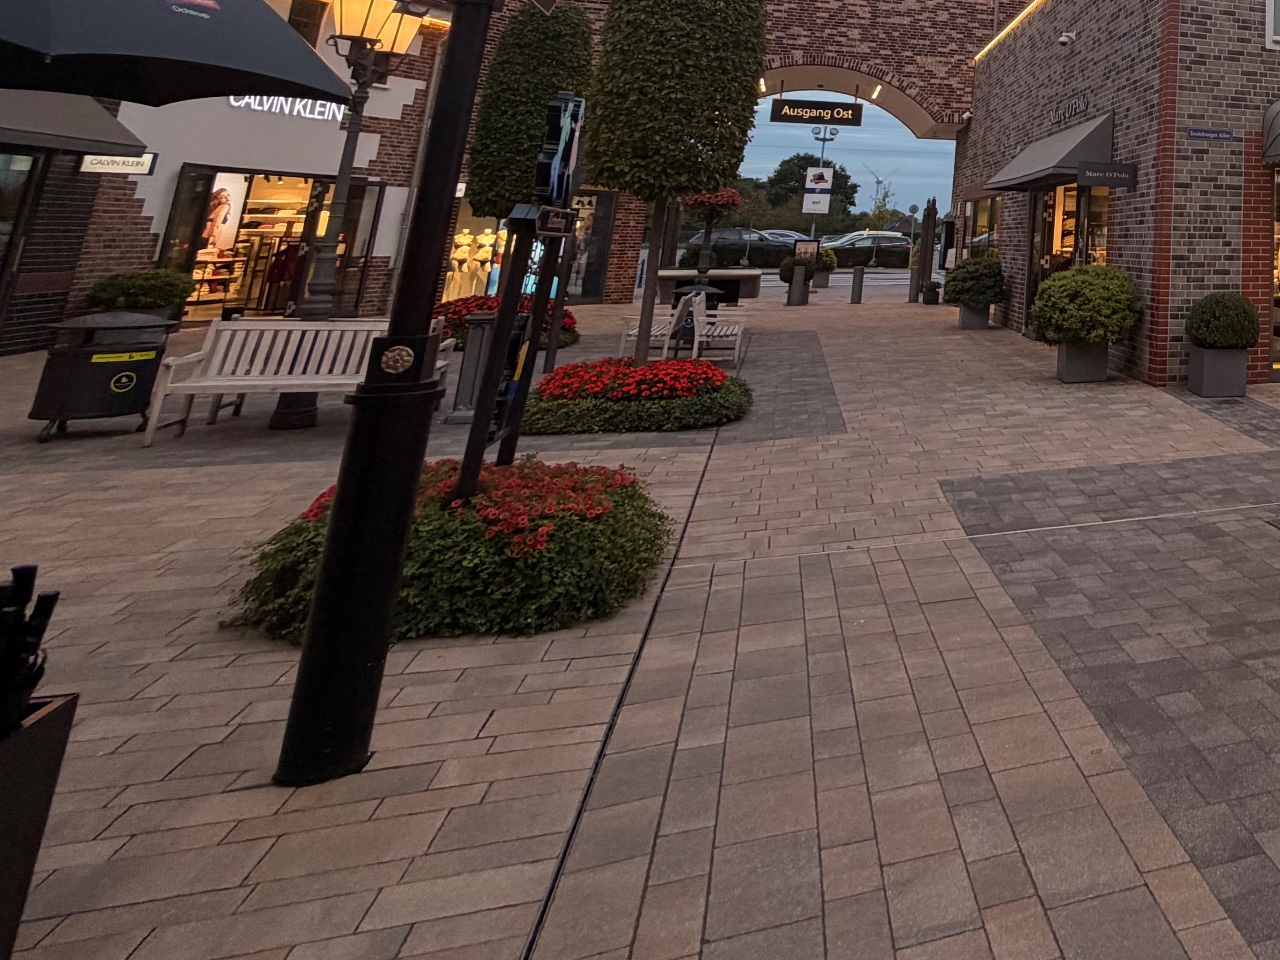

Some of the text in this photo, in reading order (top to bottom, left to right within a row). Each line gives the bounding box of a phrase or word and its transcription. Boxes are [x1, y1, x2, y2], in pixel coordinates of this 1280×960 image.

[229, 95, 345, 122] CALVIN KLEIN
[781, 105, 853, 120] Ausgang Ost
[90, 158, 145, 167] CALVIN KLEIN
